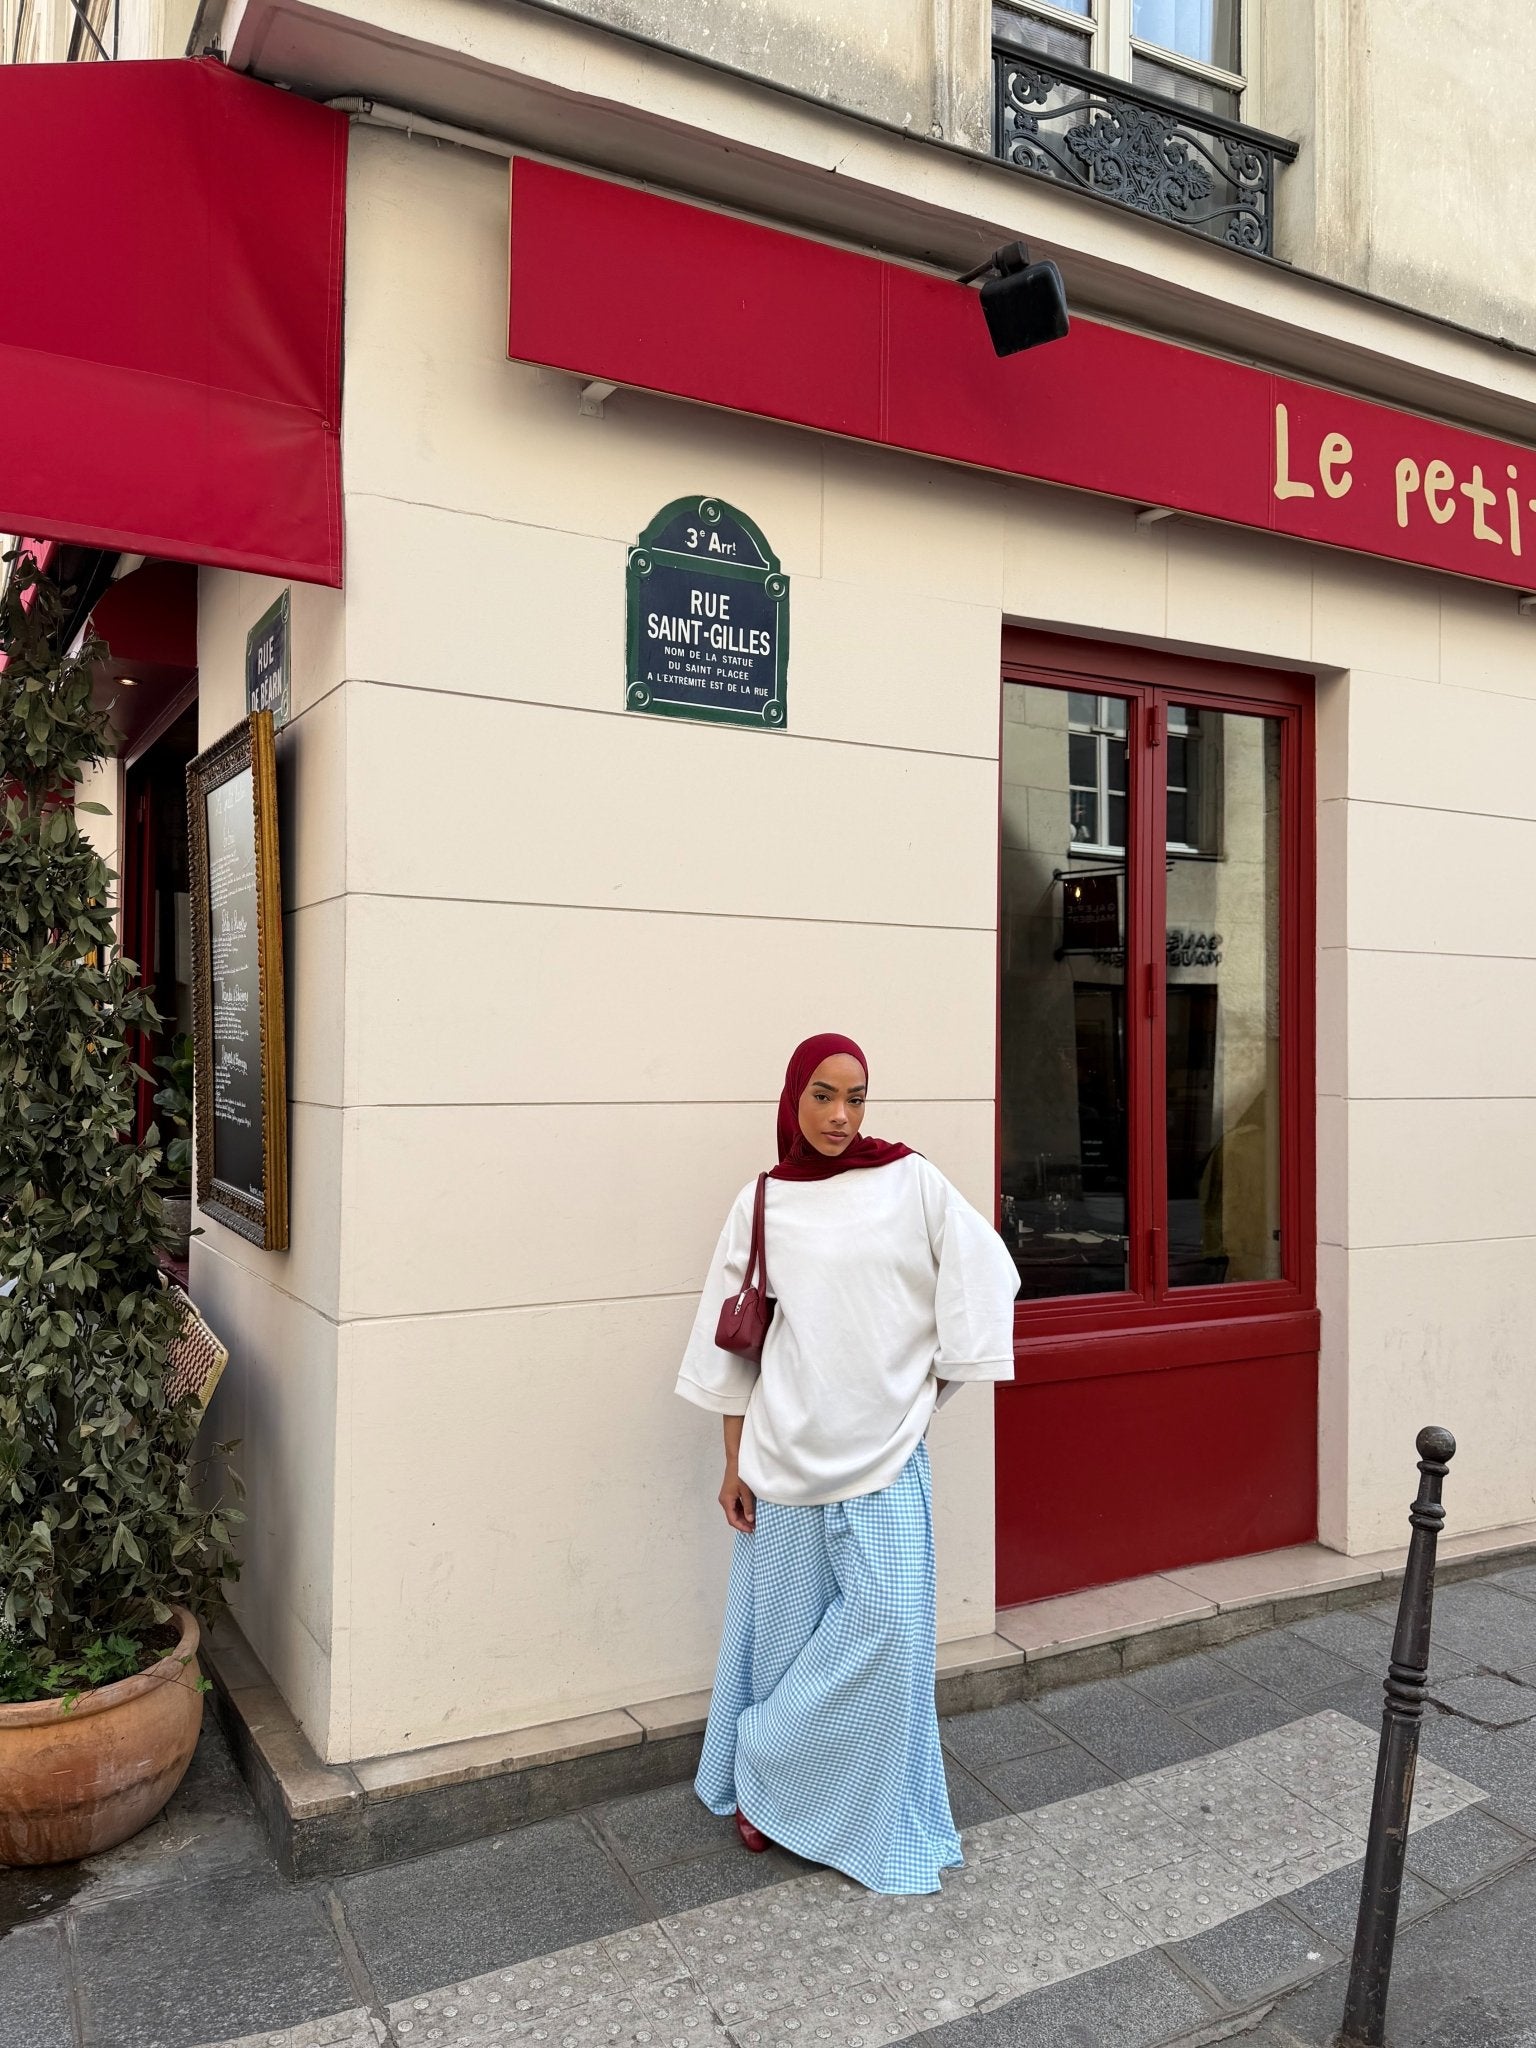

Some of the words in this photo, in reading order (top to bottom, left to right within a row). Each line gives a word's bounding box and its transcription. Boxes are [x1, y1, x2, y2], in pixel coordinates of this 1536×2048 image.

[1273, 403, 1353, 500] Le
[1395, 457, 1536, 557] peti
[690, 589, 731, 621] RUE
[647, 612, 771, 656] SAINT-GILLES
[257, 635, 275, 676] RUE
[664, 646, 685, 657] NOM
[689, 650, 701, 660] DE
[705, 652, 717, 662] LA
[722, 655, 754, 668] STATUE
[668, 660, 681, 671] DU
[685, 663, 712, 676] SAINT
[251, 687, 260, 713] DE
[260, 666, 282, 711] BÉARN
[710, 680, 724, 691] EST
[727, 683, 738, 693] DE
[740, 685, 751, 695] LA
[753, 686, 769, 697] RUE
